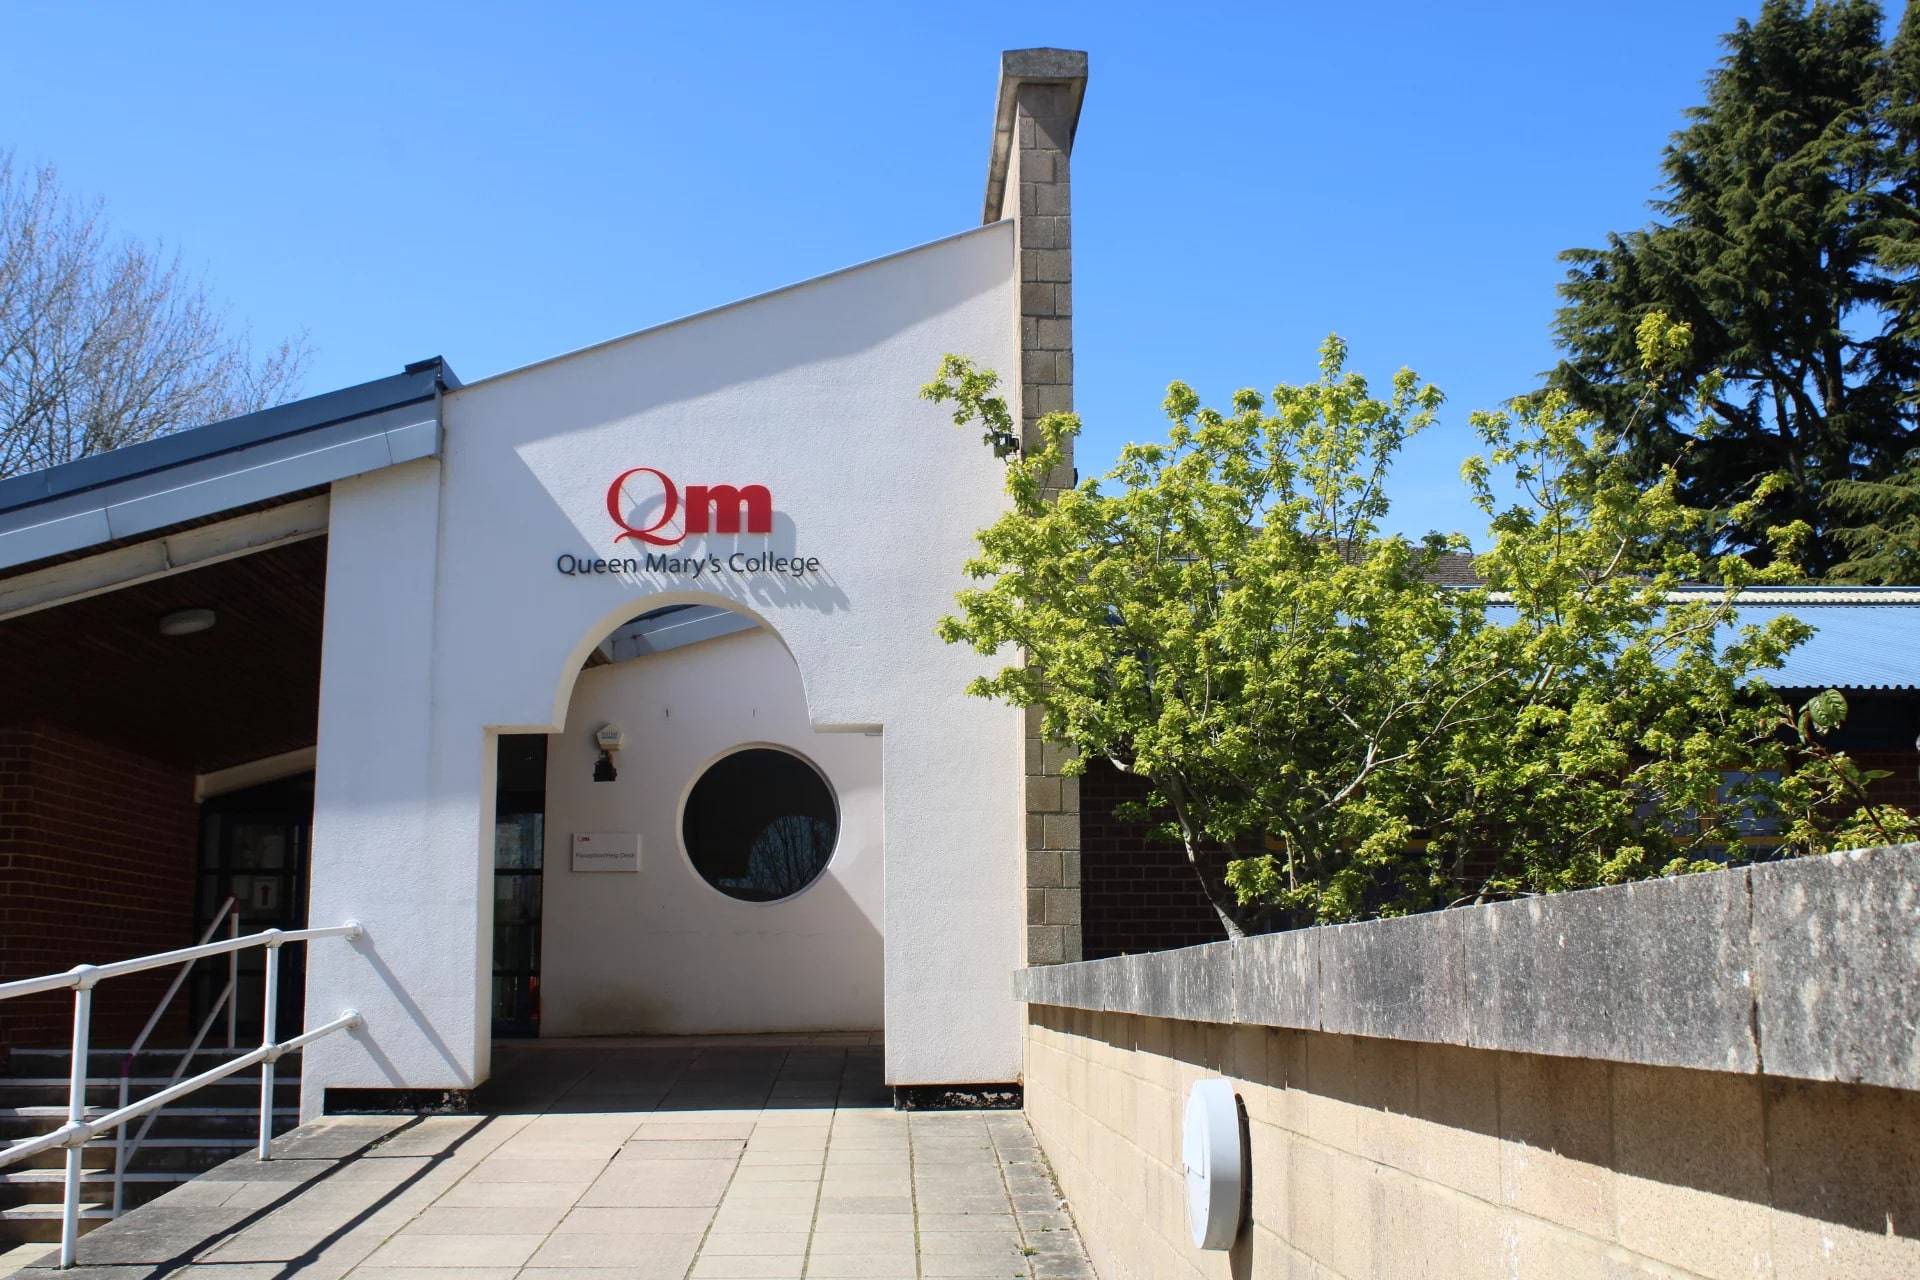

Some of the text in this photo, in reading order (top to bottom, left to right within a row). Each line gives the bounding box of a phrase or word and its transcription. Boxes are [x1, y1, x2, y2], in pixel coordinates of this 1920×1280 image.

[607, 467, 772, 546] Qm
[557, 551, 819, 579] Queen Mary's College
